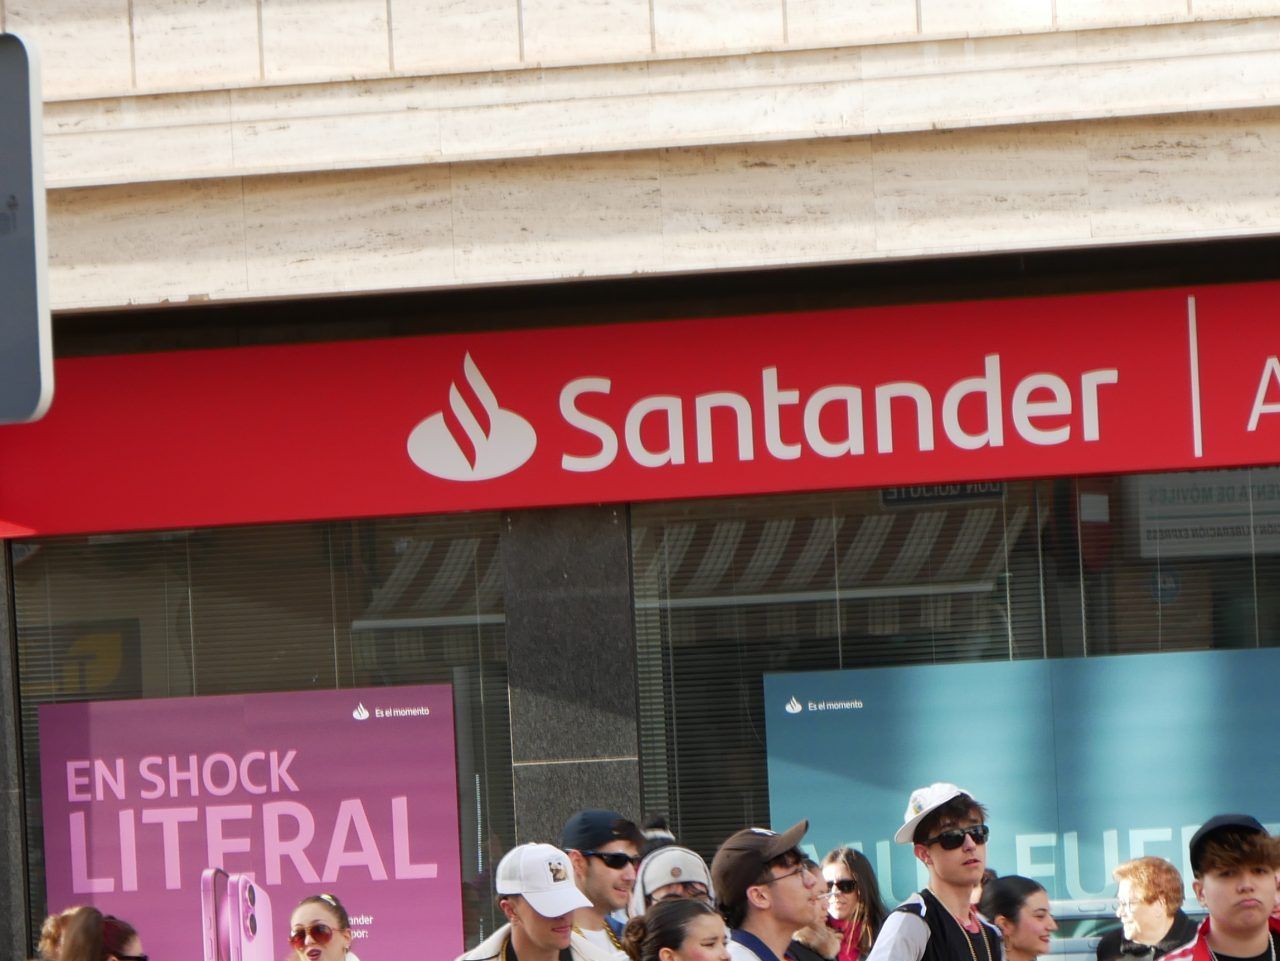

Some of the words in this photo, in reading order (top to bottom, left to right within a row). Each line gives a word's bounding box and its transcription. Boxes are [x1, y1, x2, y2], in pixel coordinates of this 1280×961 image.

[559, 353, 1118, 473] Santander
[375, 707, 384, 718] Es
[393, 706, 430, 717] momento
[808, 701, 818, 711] Es
[826, 699, 863, 710] momento
[66, 758, 126, 802] EN
[138, 750, 300, 800] SHOCK
[69, 796, 438, 894] LITERAL
